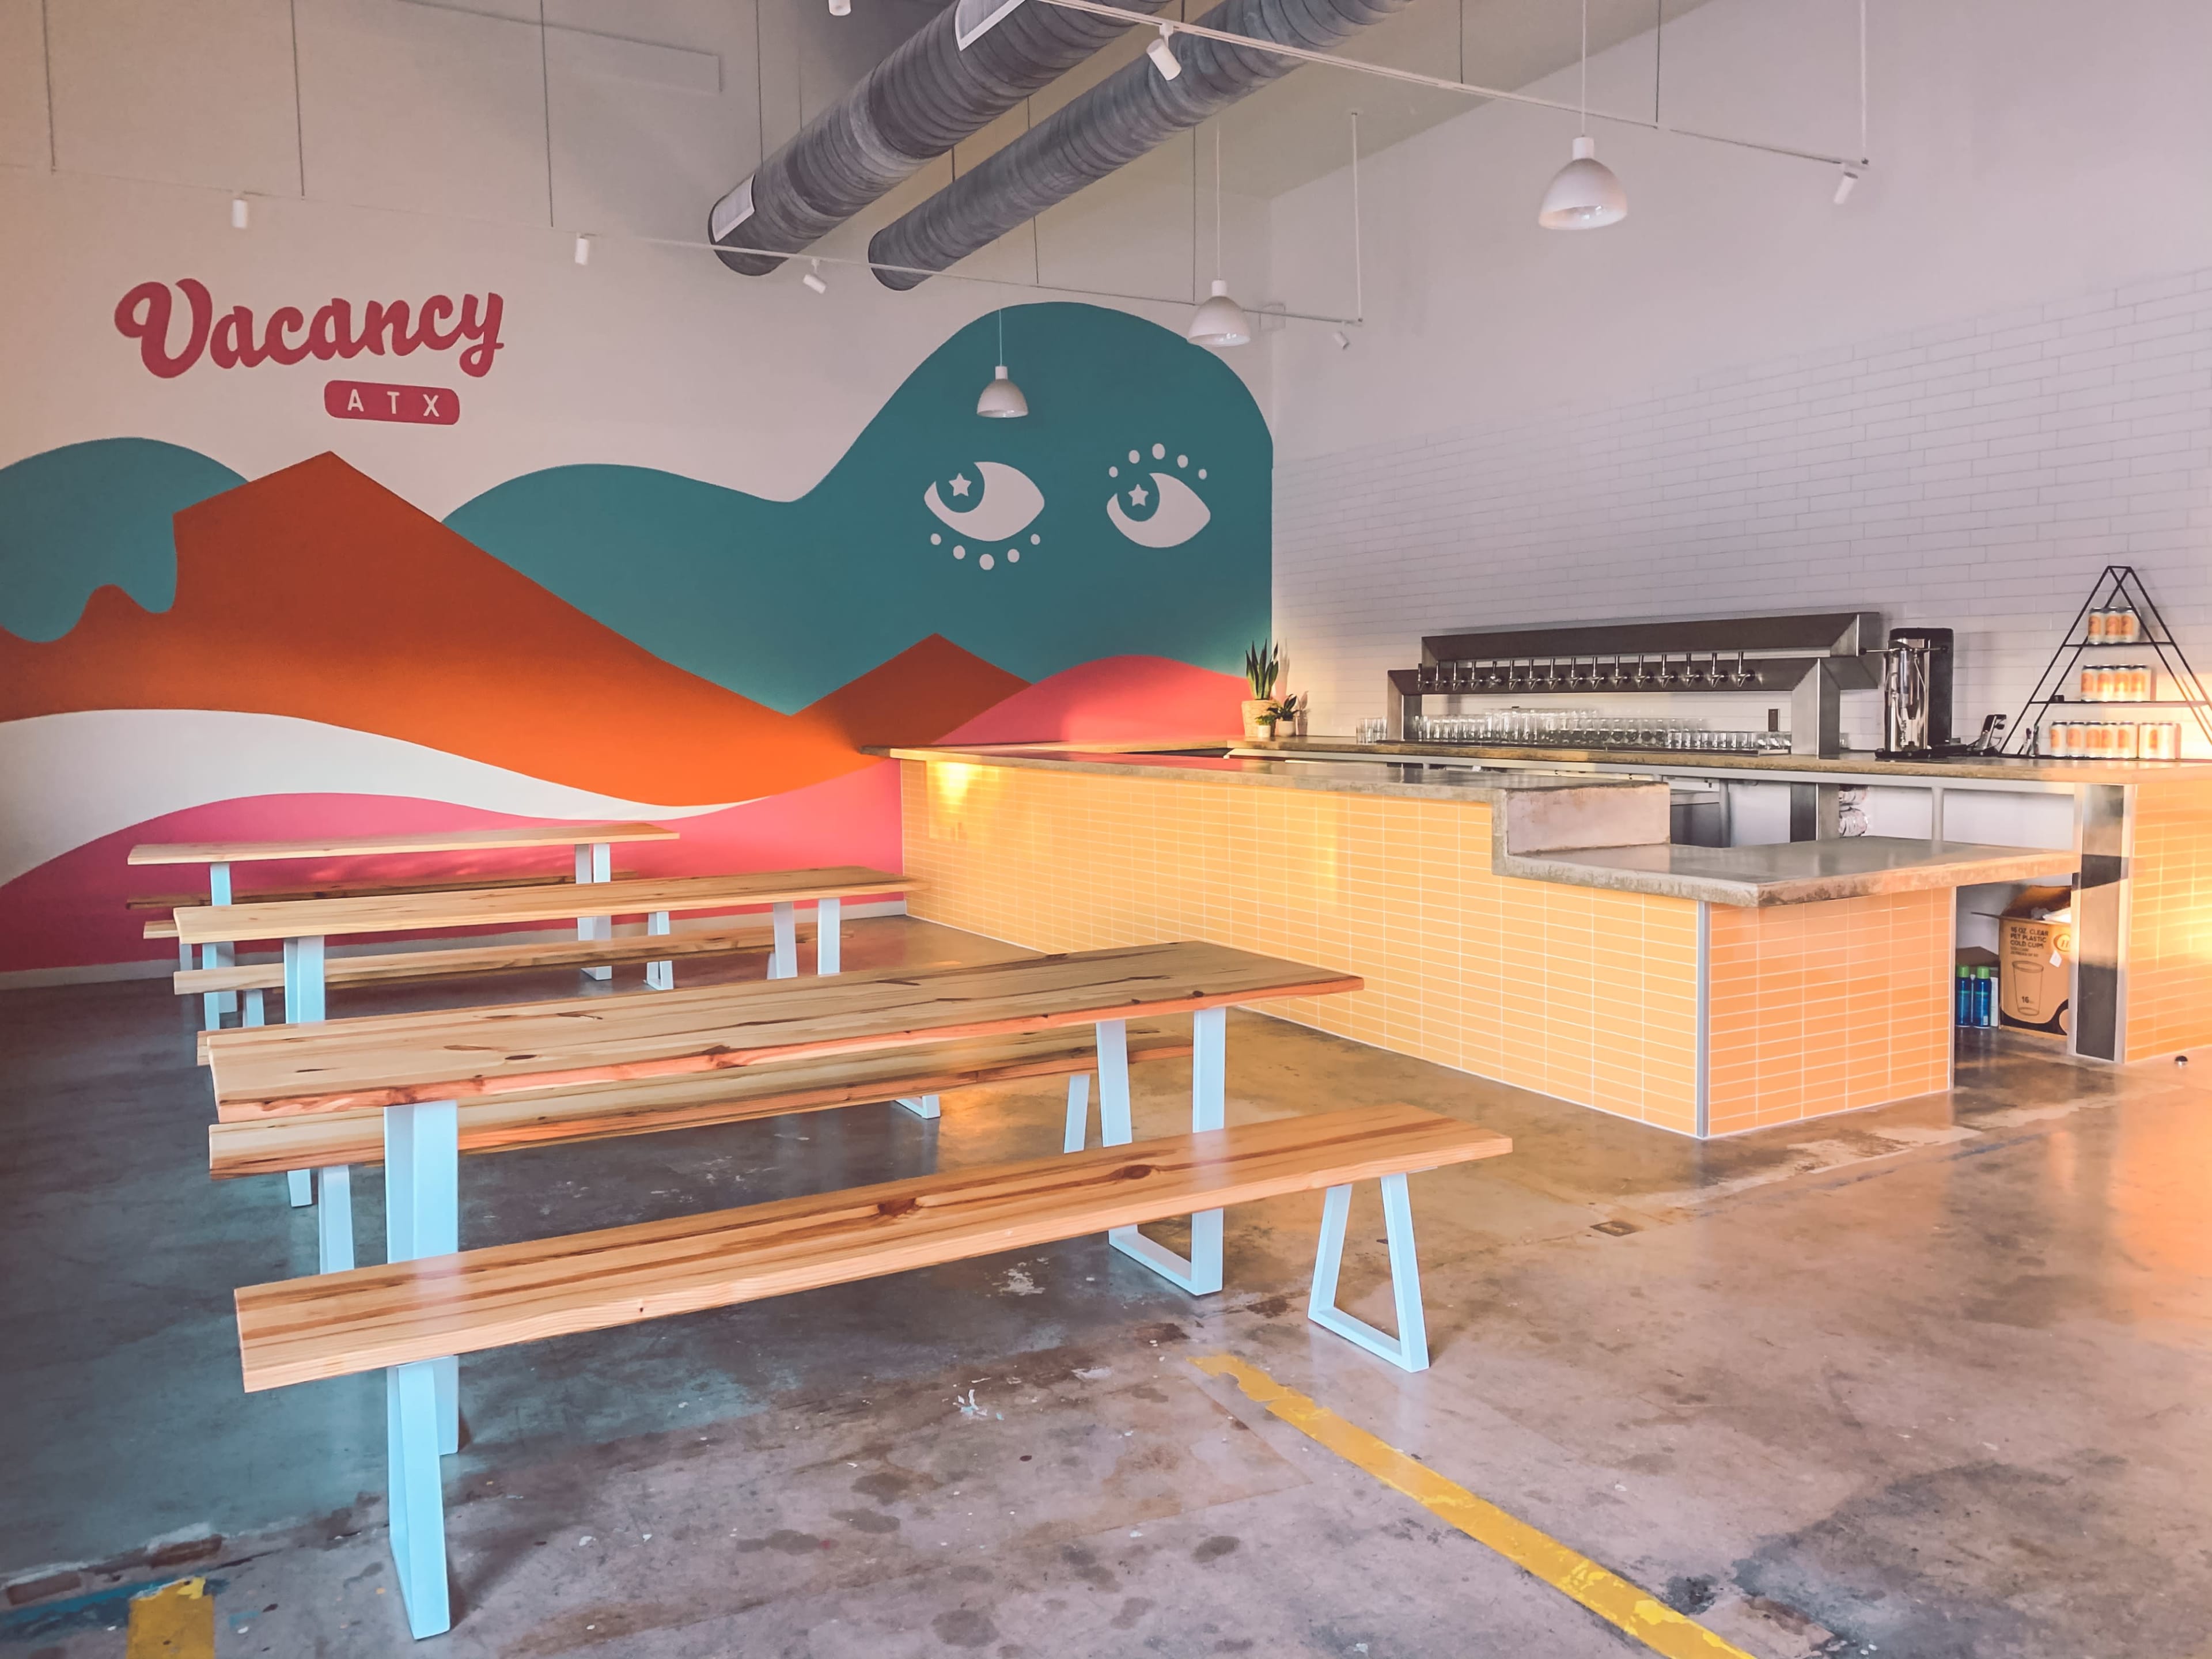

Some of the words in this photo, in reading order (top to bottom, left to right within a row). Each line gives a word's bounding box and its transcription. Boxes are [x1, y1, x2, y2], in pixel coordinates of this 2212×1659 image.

[115, 278, 503, 378] Vacancy
[347, 389, 440, 417] ATX
[2022, 934, 2047, 942] PLASTIC
